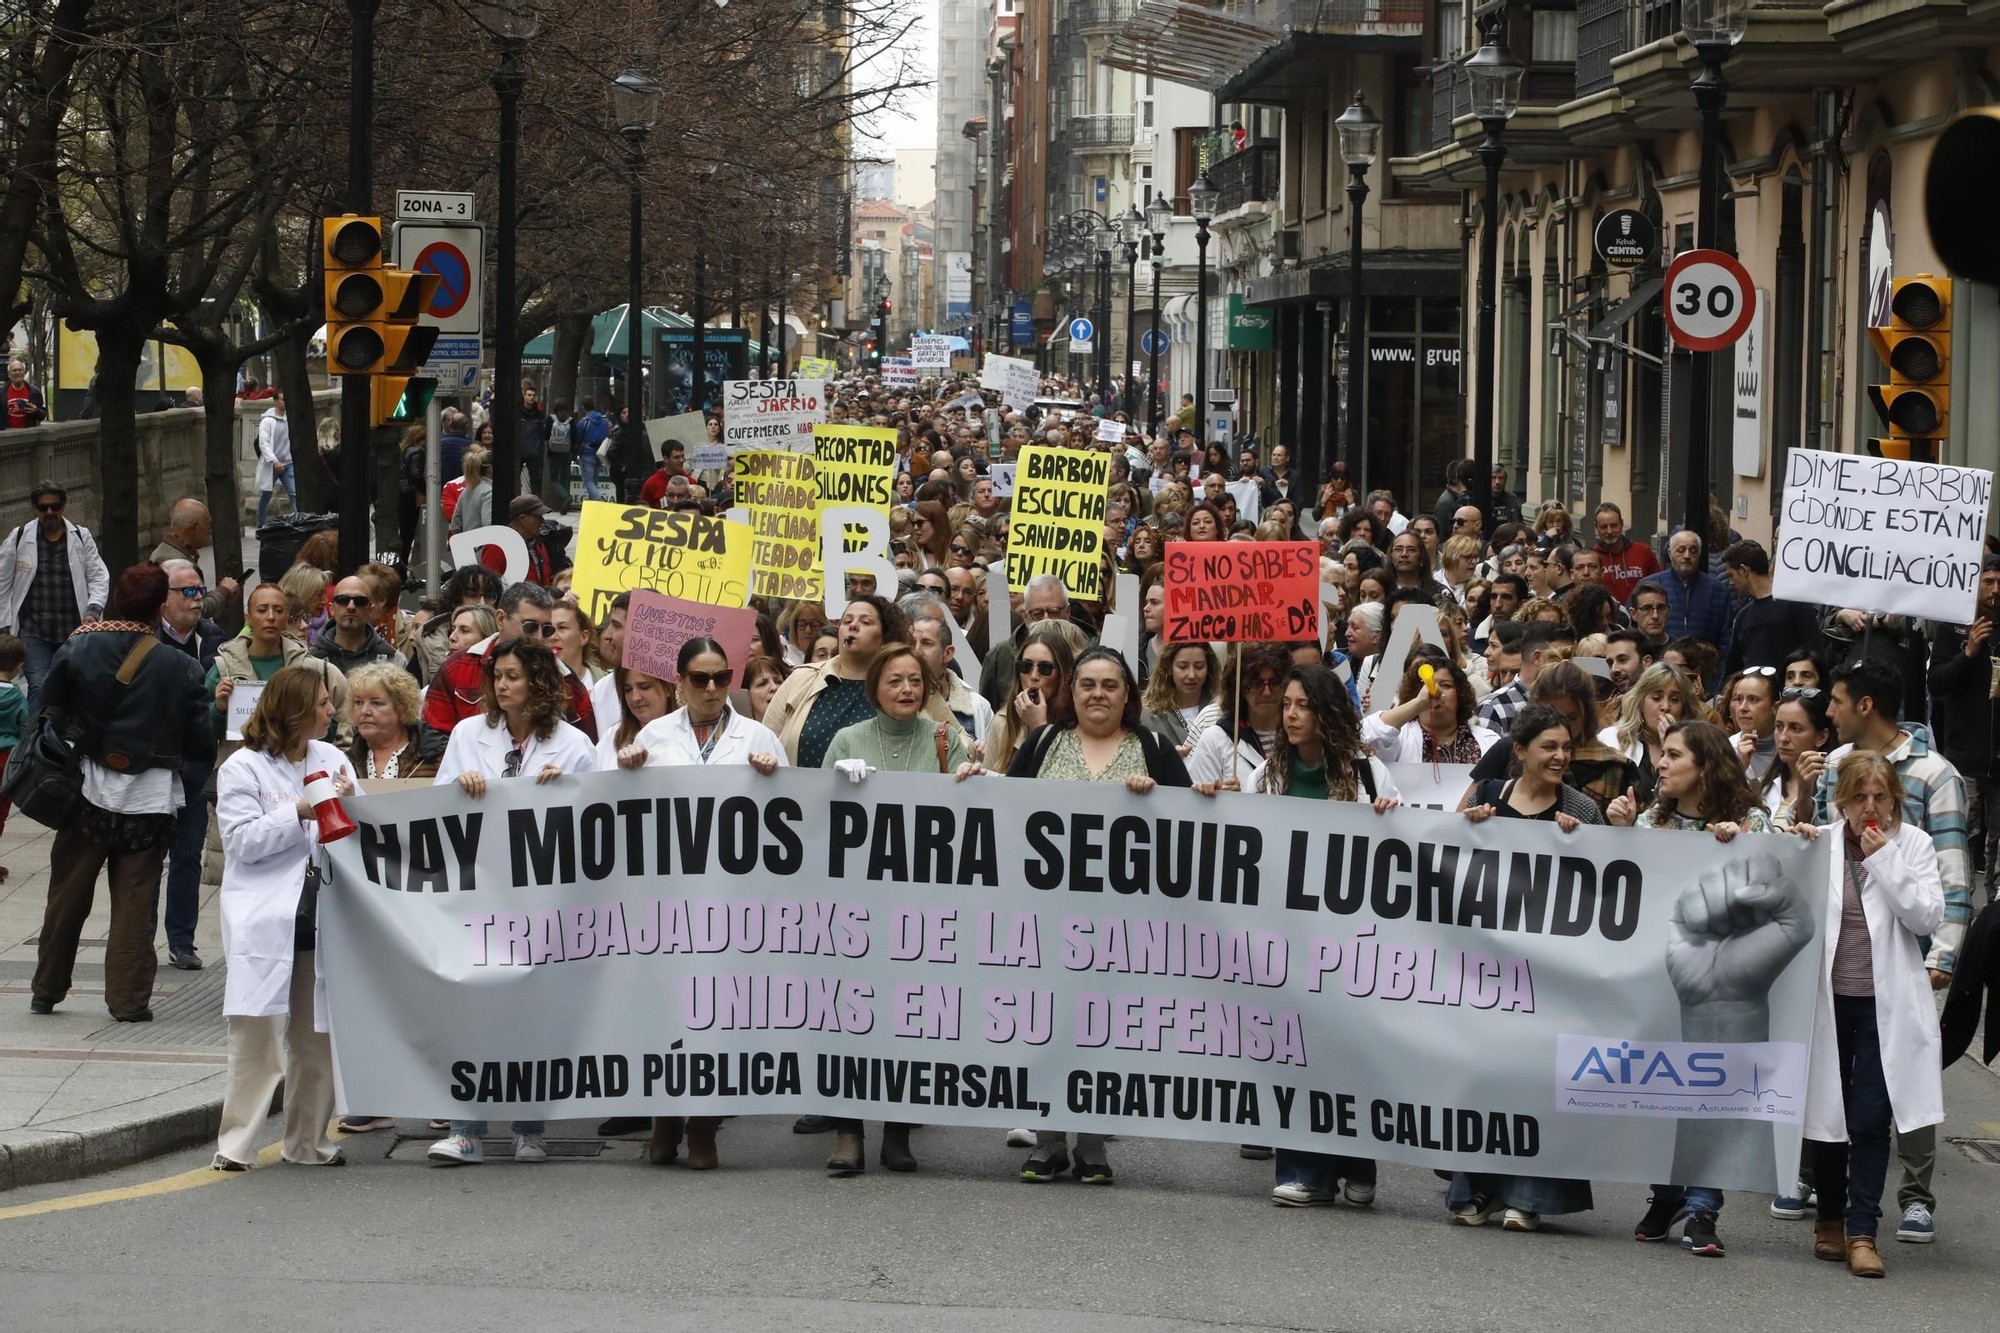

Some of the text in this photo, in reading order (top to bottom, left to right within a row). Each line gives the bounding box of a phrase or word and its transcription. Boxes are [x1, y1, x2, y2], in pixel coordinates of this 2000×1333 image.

[403, 199, 443, 213] ZONA
[457, 203, 466, 214] 3
[1607, 246, 1644, 255] CENTRO
[1675, 282, 1734, 318] 30
[1371, 348, 1415, 361] www.
[731, 380, 797, 400] SESPA
[757, 393, 817, 413] JARRIO
[727, 424, 791, 440] ENFERMERAS
[735, 454, 815, 482] SOMETID
[814, 436, 895, 467] RECORTAD
[1027, 452, 1107, 485] BARBÓN
[1791, 453, 1867, 495] DIME,
[815, 467, 890, 505] SILLONES
[1017, 486, 1105, 521] ESCUCHA
[1788, 489, 1876, 531] ¿DÓNDE
[1885, 505, 1952, 537] ESTÁ
[614, 508, 726, 555] SESPA
[1012, 521, 1098, 553] SANIDAD
[1006, 553, 1035, 586] EN
[1204, 555, 1232, 581] NO
[1237, 548, 1314, 580] SABES
[1615, 569, 1643, 579] JONES
[1782, 537, 1980, 593] CONCILIACIÓN?
[619, 564, 745, 609] CREO TUS
[1170, 581, 1284, 613] MANDAR,
[635, 603, 716, 632] NUESTROS
[1242, 612, 1275, 639] HAS
[1276, 617, 1287, 629] DE
[630, 636, 650, 653] NO
[629, 652, 677, 681] PRIVIL
[360, 795, 1643, 942] HAY MOTIVOS PARA SEGUIR LUCHANDO
[465, 900, 1536, 1014] TRABAJADORXS DE LA SANIDAD PÚBLICA
[682, 974, 1308, 1067] UNIDXS EN SU DEFENSA
[1571, 1041, 1727, 1087] ATAS
[450, 1038, 1541, 1158] SANIDAD PÚBLICA UNIVERSAL, GRATUITA Y DE CALIDAD
